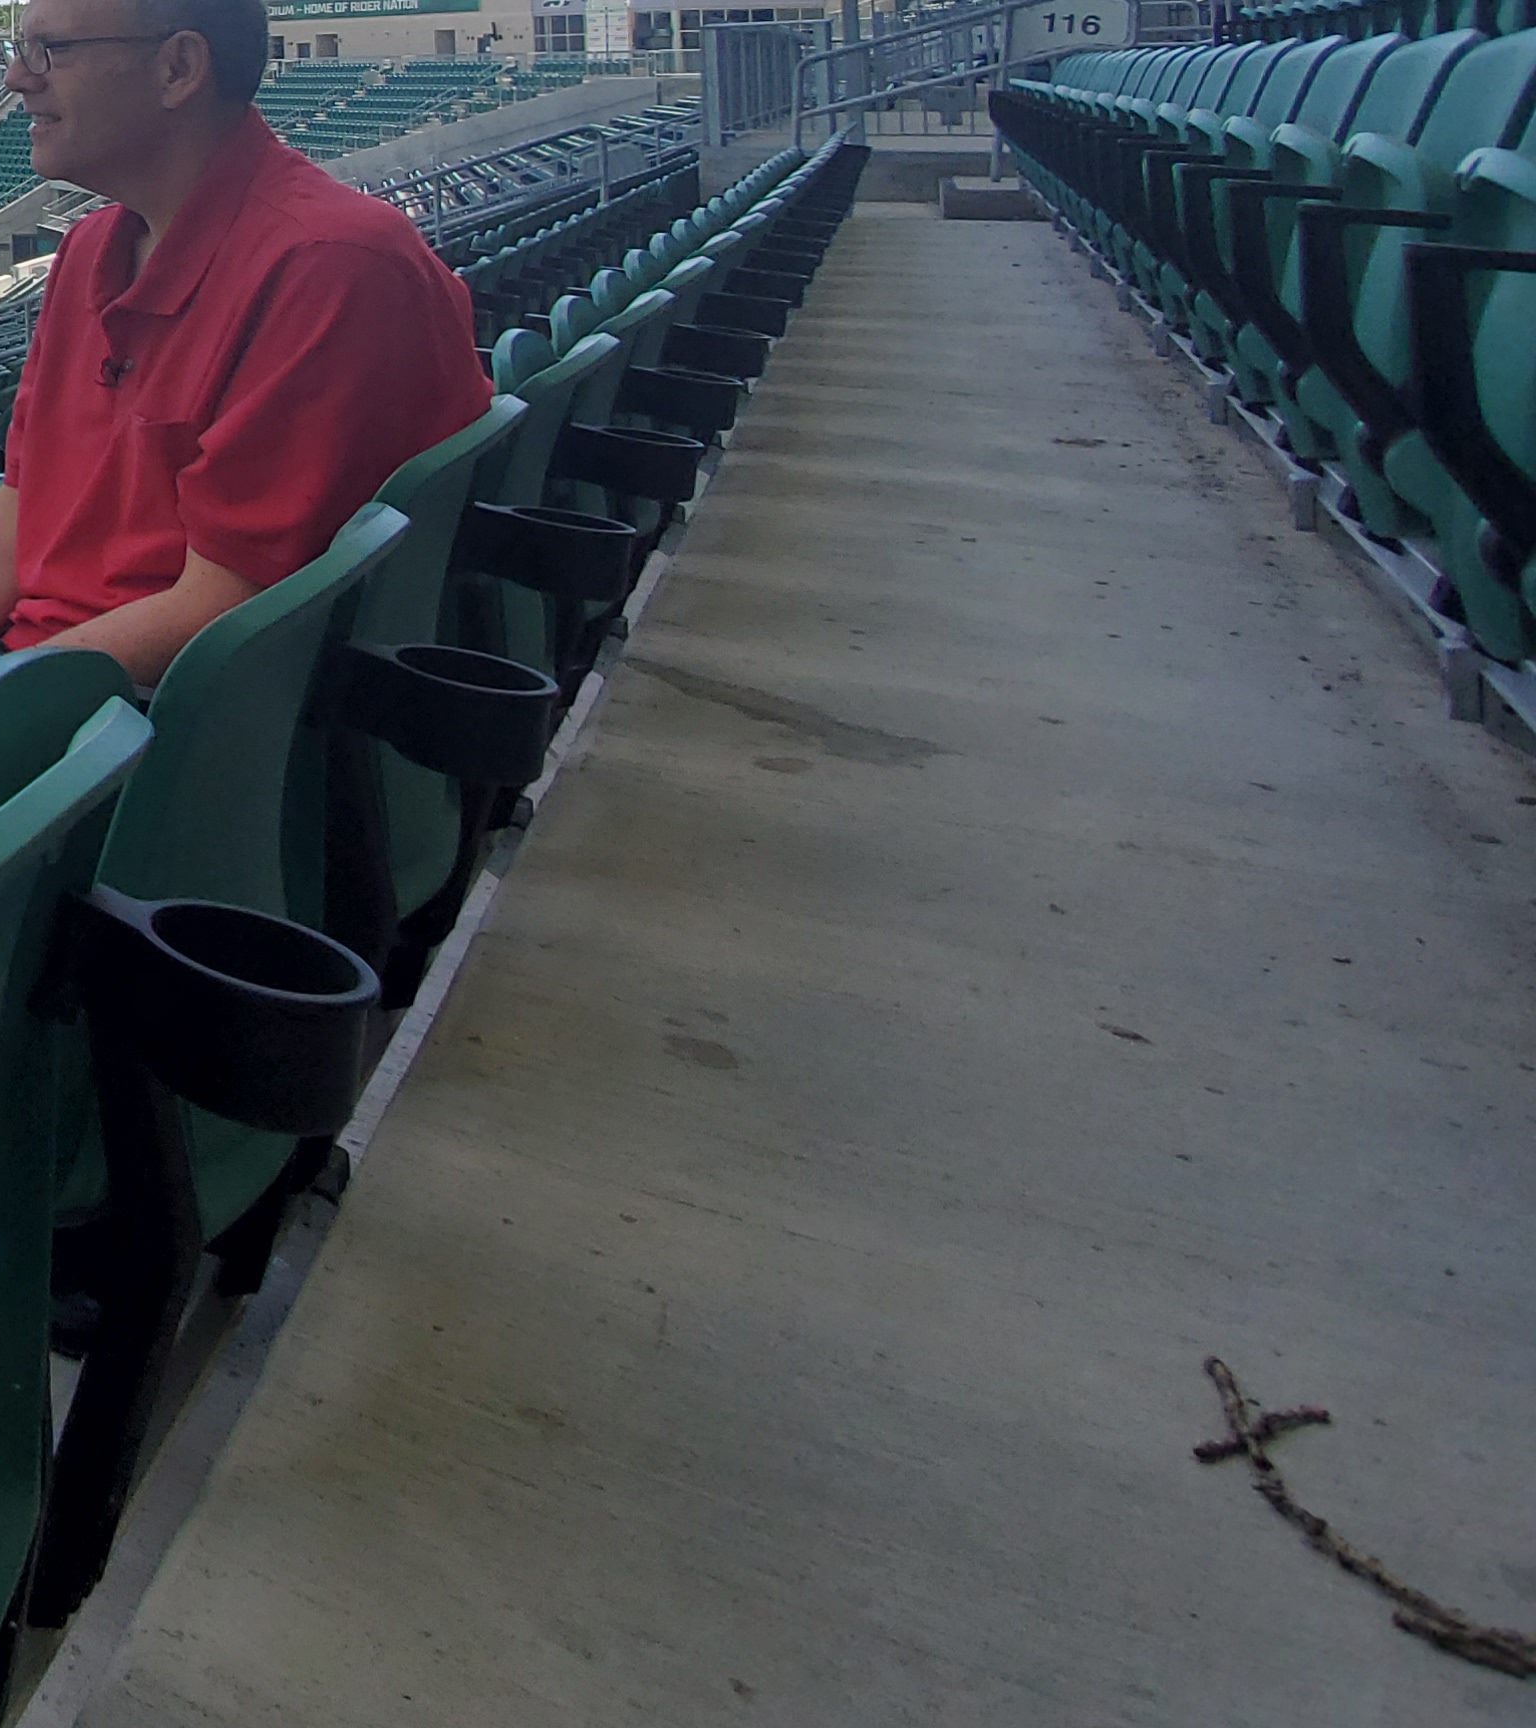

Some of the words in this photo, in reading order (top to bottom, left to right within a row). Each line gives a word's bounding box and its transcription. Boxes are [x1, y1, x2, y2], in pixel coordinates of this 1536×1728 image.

[304, 0, 333, 14] HOME
[335, 1, 349, 13] OF
[350, 0, 381, 13] RIDER
[1043, 13, 1101, 35] 116
